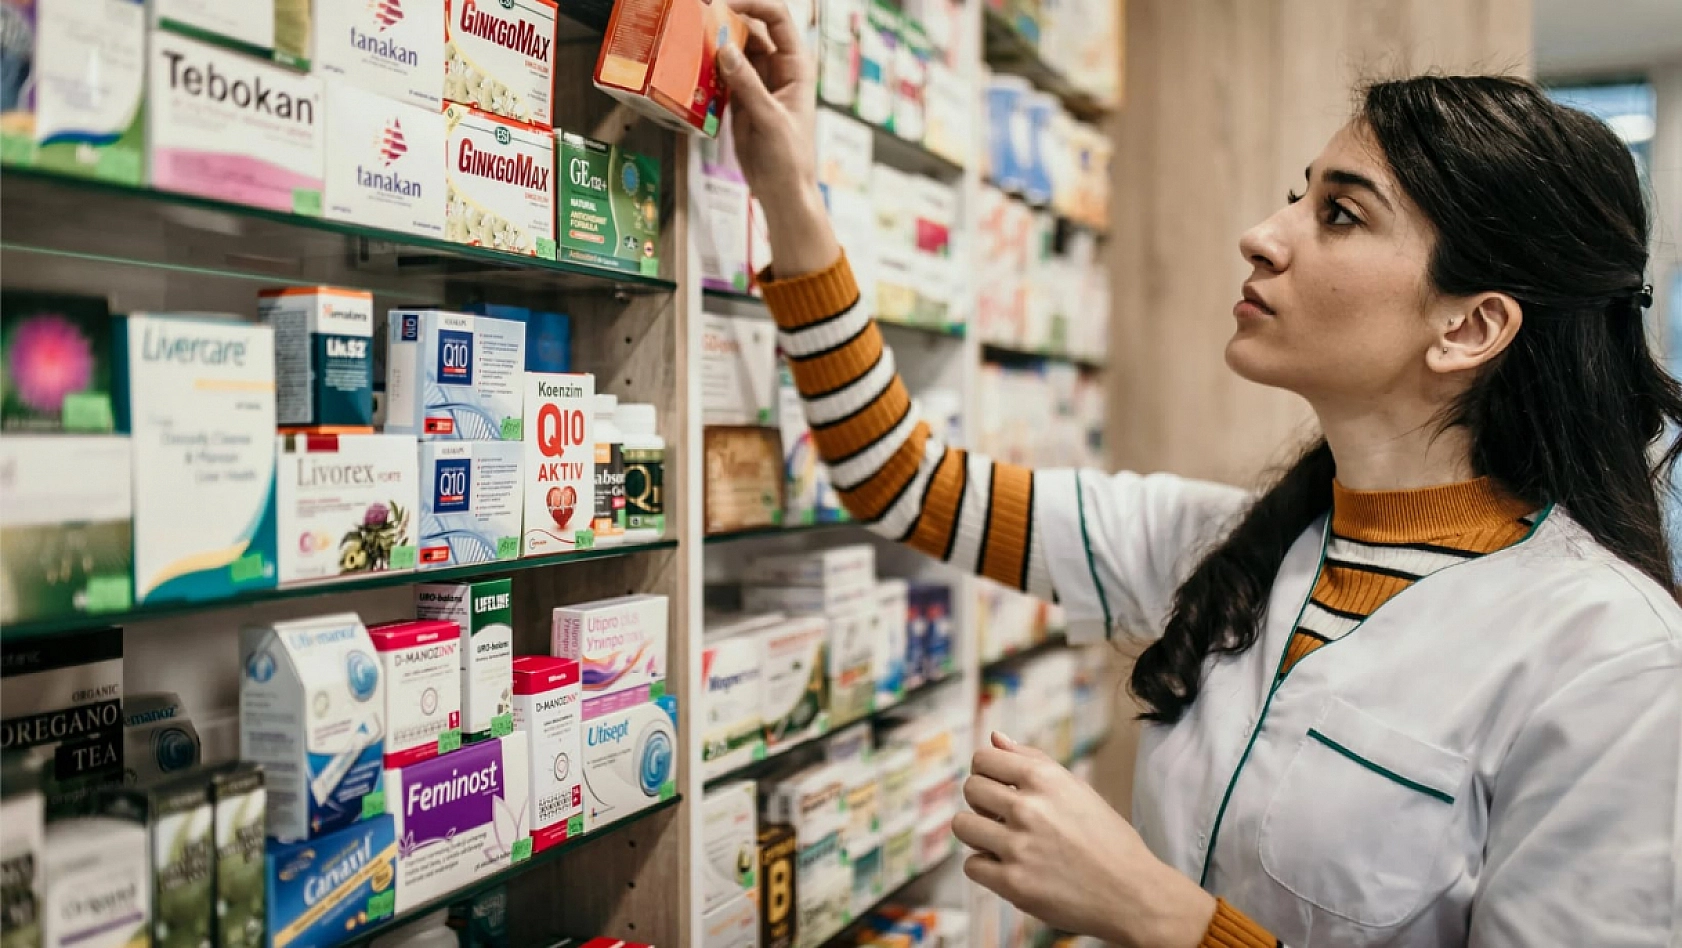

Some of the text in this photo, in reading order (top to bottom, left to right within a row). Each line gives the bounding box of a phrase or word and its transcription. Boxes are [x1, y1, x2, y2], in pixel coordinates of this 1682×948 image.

[350, 27, 418, 67] tanakan
[162, 50, 313, 124] Tebokan
[496, 128, 511, 144] ESI
[356, 165, 422, 198] tanakan
[141, 325, 248, 367] Livercare
[443, 343, 468, 368] Q10
[538, 380, 583, 398] Koenzim
[536, 402, 585, 458] Q10
[296, 458, 374, 486] Livorex
[440, 471, 466, 496] Q10
[537, 462, 584, 482] AKTIV
[474, 592, 510, 614] LIFELINE
[587, 613, 619, 634] Utipro
[71, 683, 119, 702] ORGANIC
[0, 703, 118, 747] OREGANO
[587, 718, 629, 747] Utisept
[71, 741, 118, 771] TEA
[406, 761, 498, 817] Feminost
